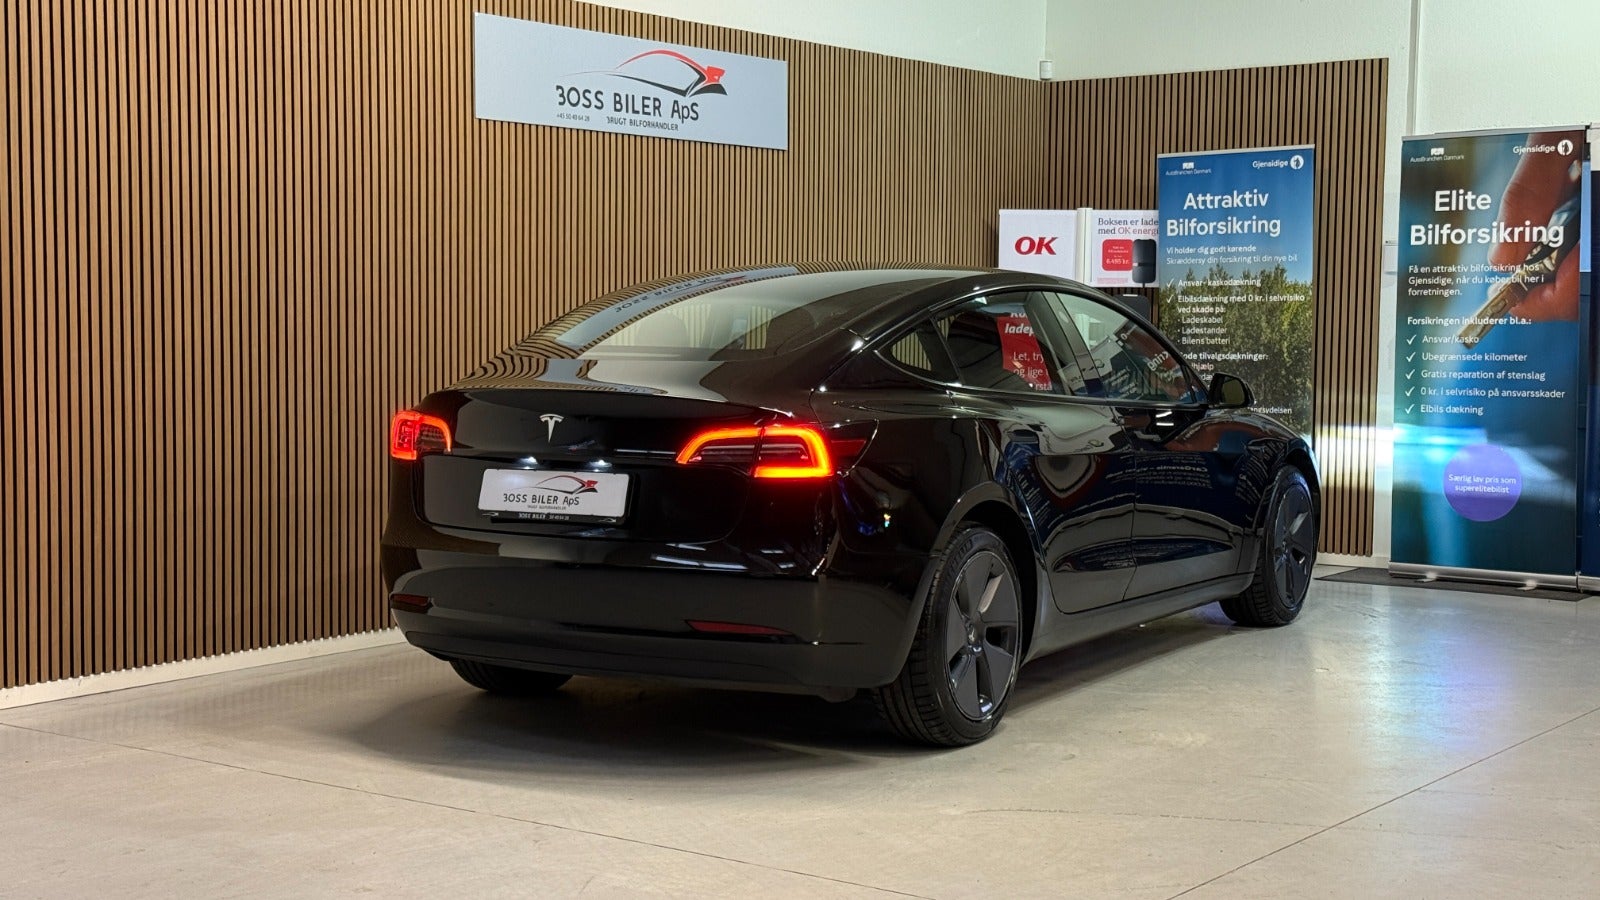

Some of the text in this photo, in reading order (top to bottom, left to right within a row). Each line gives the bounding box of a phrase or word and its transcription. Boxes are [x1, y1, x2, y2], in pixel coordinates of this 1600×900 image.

[613, 92, 662, 117] BILER
[671, 100, 699, 124] ApS
[629, 119, 679, 131] BILFORHANDLER
[1512, 144, 1556, 155] Gjensidige
[1252, 159, 1289, 170] Gjensidige
[1183, 188, 1270, 211] Attraktiv
[1434, 188, 1492, 212] Elite
[1097, 217, 1128, 226] Boksen
[1141, 217, 1159, 226] lade
[1166, 215, 1281, 238] Bilforsikring
[1097, 227, 1116, 235] med
[1117, 226, 1131, 235] OK
[1410, 220, 1565, 249] Bilforsikring
[1014, 236, 1059, 256] OK
[1174, 246, 1197, 254] holder
[1197, 246, 1209, 255] dig
[1209, 246, 1227, 255] godt
[1227, 244, 1257, 253] kørende
[1166, 256, 1206, 266] Skræddersy
[1206, 256, 1218, 264] din
[1219, 255, 1252, 265] forsikring
[1262, 254, 1273, 262] din
[1273, 255, 1287, 264] nye
[1288, 254, 1298, 262] bil
[1408, 265, 1419, 273] Få
[1432, 264, 1468, 273] attraktiv
[1470, 263, 1521, 274] bilforsikring
[1523, 262, 1540, 271] hos
[1207, 278, 1262, 288] kaskodækning
[1408, 274, 1545, 286] Gjensidige, når du køber bil her i
[1407, 287, 1463, 298] forretningen.
[1178, 294, 1229, 304] Elbilsdækning
[1229, 294, 1247, 303] med
[1248, 294, 1253, 302] 0
[1254, 294, 1265, 302] kr.
[1269, 293, 1306, 302] selvrisiko
[1177, 305, 1226, 315] ved skade på:
[1181, 316, 1224, 324] Ladeskabel
[1407, 316, 1533, 327] Forsikringen inkluderer bl.a.:
[1005, 322, 1035, 337] ladep
[1181, 326, 1228, 335] Ladestander
[1181, 336, 1231, 345] Bilens batteri
[1422, 334, 1480, 345] Ansvar/kasko
[1013, 351, 1045, 364] Let, try
[1198, 351, 1269, 362] tilvalgsdækninger:
[1422, 352, 1529, 363] Ubegrænsede kilometer
[1421, 369, 1547, 382] Gratis reparation af stenslag
[1420, 387, 1427, 396] 0
[1428, 387, 1439, 396] kr.
[1444, 387, 1487, 397] selvrisiko
[1488, 388, 1500, 399] på
[1501, 389, 1566, 399] ansvarsskader
[1420, 404, 1485, 416] Elbils dækning
[1448, 473, 1472, 484] Særlig
[1472, 474, 1484, 483] lav
[1484, 476, 1499, 486] pris
[1454, 484, 1510, 494] superelitebilist
[531, 494, 559, 505] BILER
[562, 496, 580, 507] ApS
